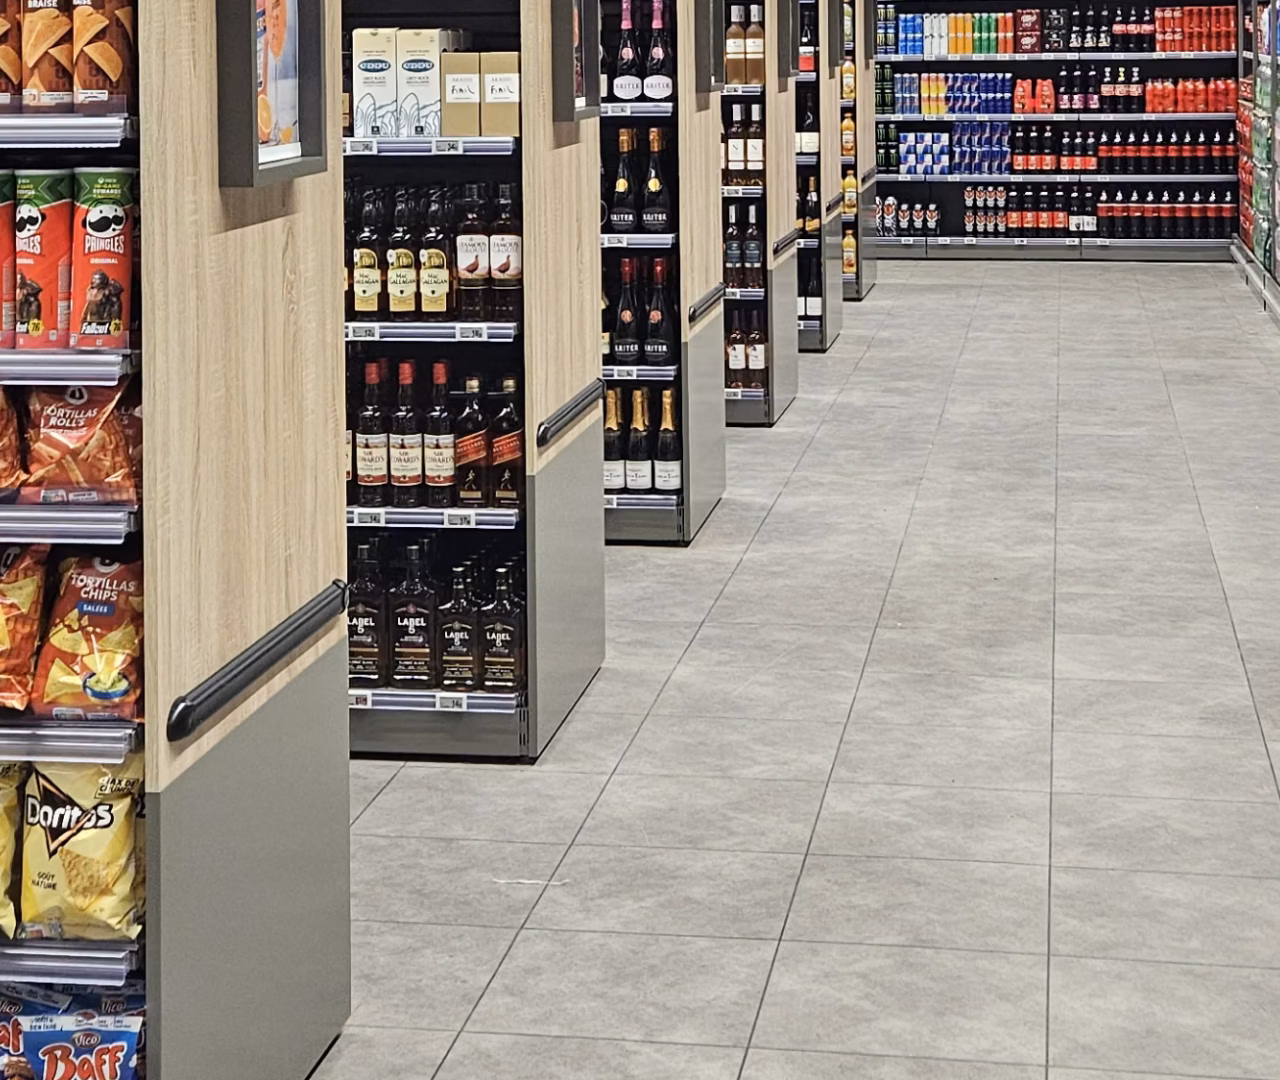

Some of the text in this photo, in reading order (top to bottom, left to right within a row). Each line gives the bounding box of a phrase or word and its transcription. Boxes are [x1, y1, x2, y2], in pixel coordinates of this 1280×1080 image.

[84, 234, 125, 255] PRINGLES
[71, 574, 136, 592] TORTILLAS
[80, 588, 118, 601] CHIPS
[397, 616, 427, 626] LABEL
[444, 631, 469, 640] LABEL
[486, 631, 511, 640] LABEL
[26, 796, 114, 830] Doritos
[74, 1033, 99, 1046] Vico
